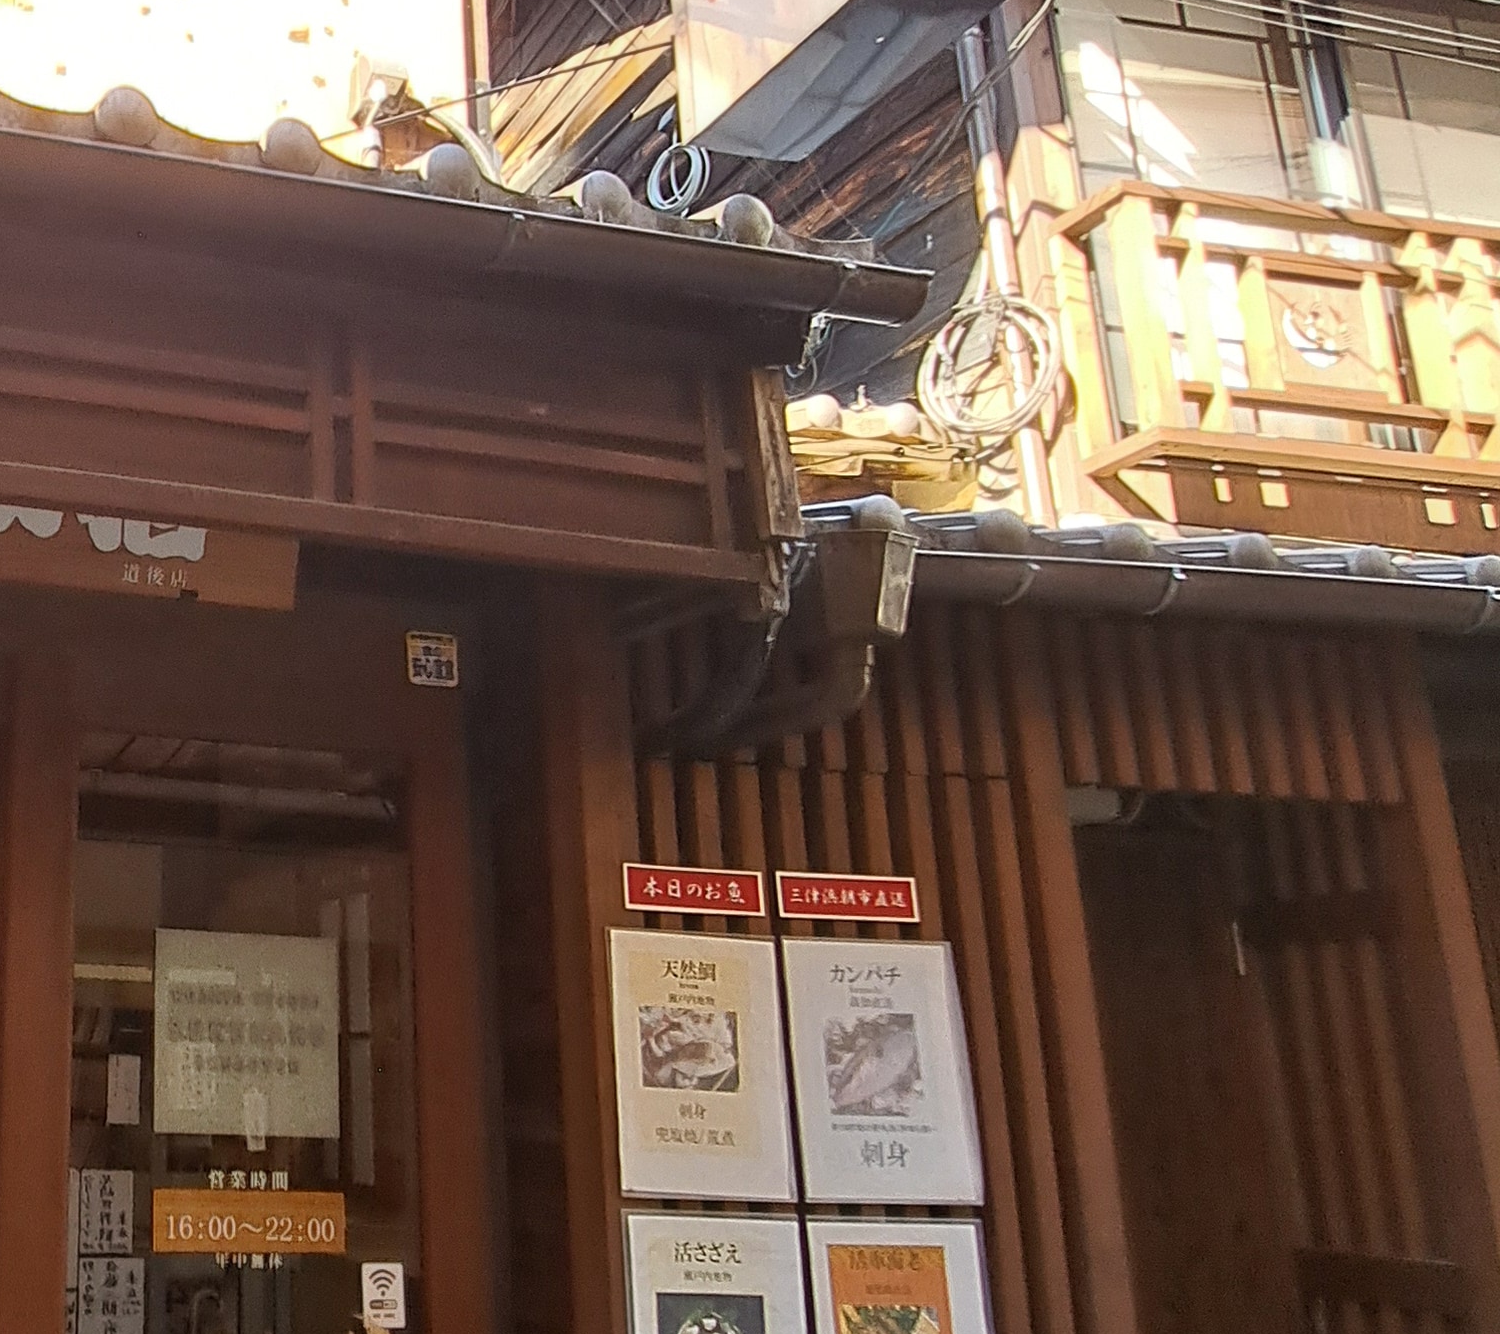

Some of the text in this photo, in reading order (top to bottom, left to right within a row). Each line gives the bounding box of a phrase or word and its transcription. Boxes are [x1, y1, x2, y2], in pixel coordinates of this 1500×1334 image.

[121, 562, 190, 590] 道後店
[642, 875, 746, 905] 本日のお魚
[788, 886, 908, 910] 三津浜朝市直送
[661, 959, 718, 983] 天然鯛
[829, 963, 902, 986] カンパチ
[678, 1102, 707, 1121] 刺身
[860, 1139, 911, 1168] 刺身
[207, 1168, 290, 1191] 営業時間
[673, 1241, 743, 1265] 活さざえ
